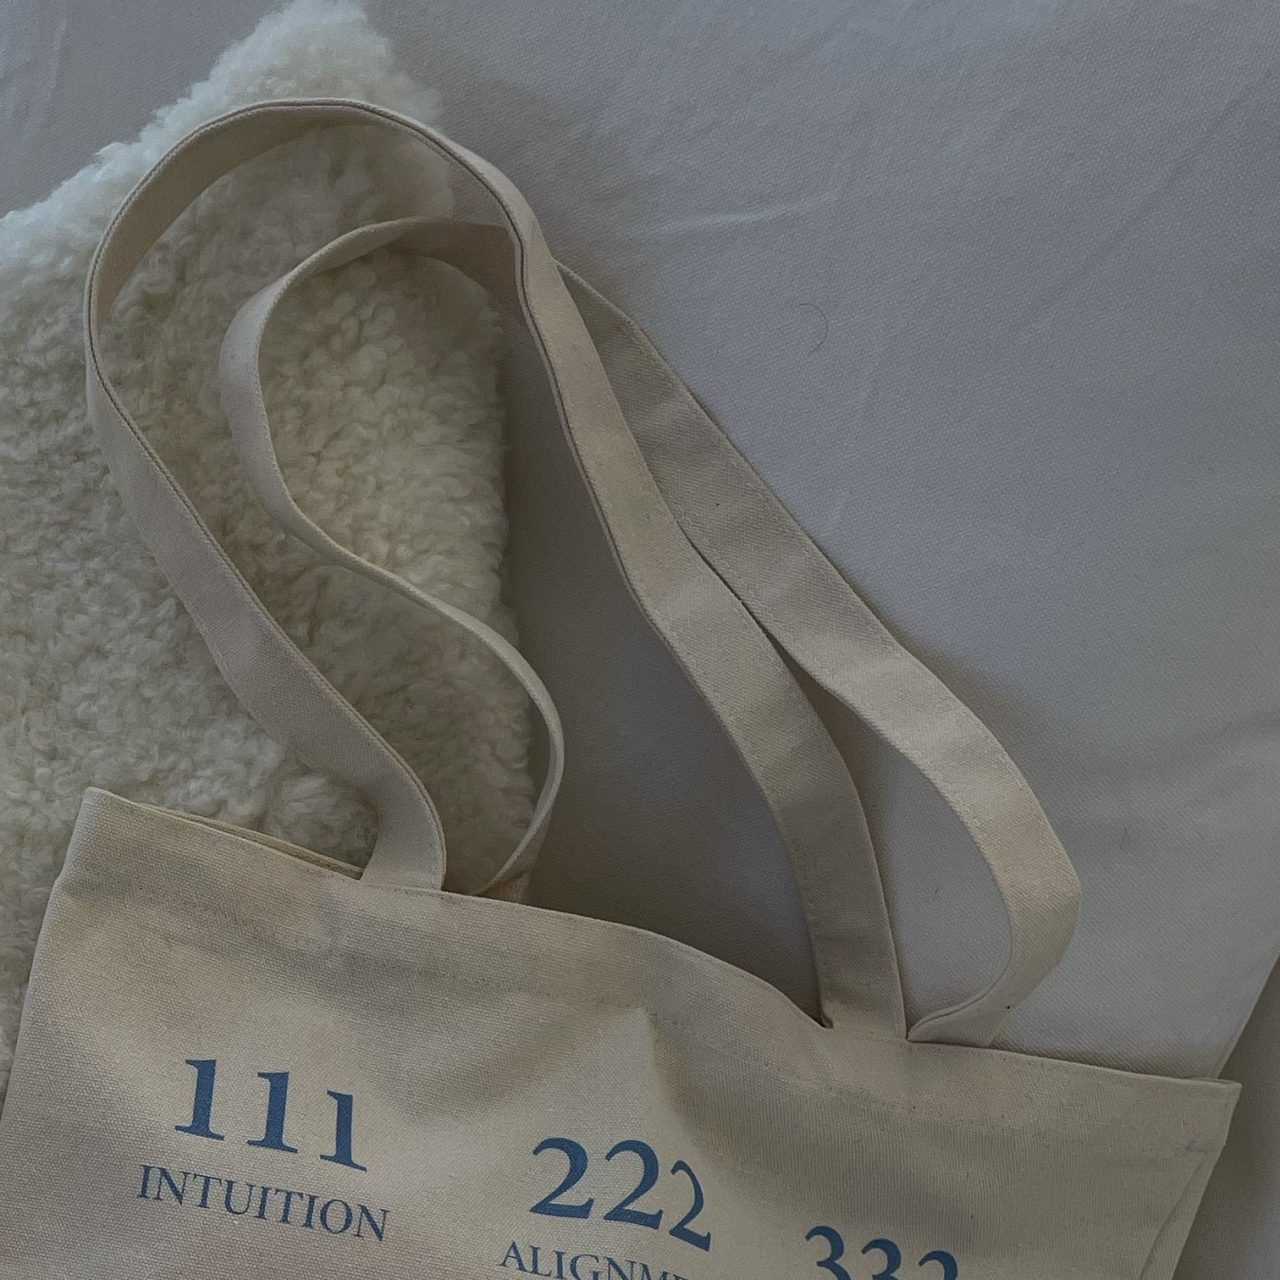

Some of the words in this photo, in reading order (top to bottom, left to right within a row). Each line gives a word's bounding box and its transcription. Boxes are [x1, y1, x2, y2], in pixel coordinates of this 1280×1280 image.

[174, 1058, 369, 1172] 111
[136, 1163, 389, 1242] INTUITION
[529, 1136, 713, 1251] 222
